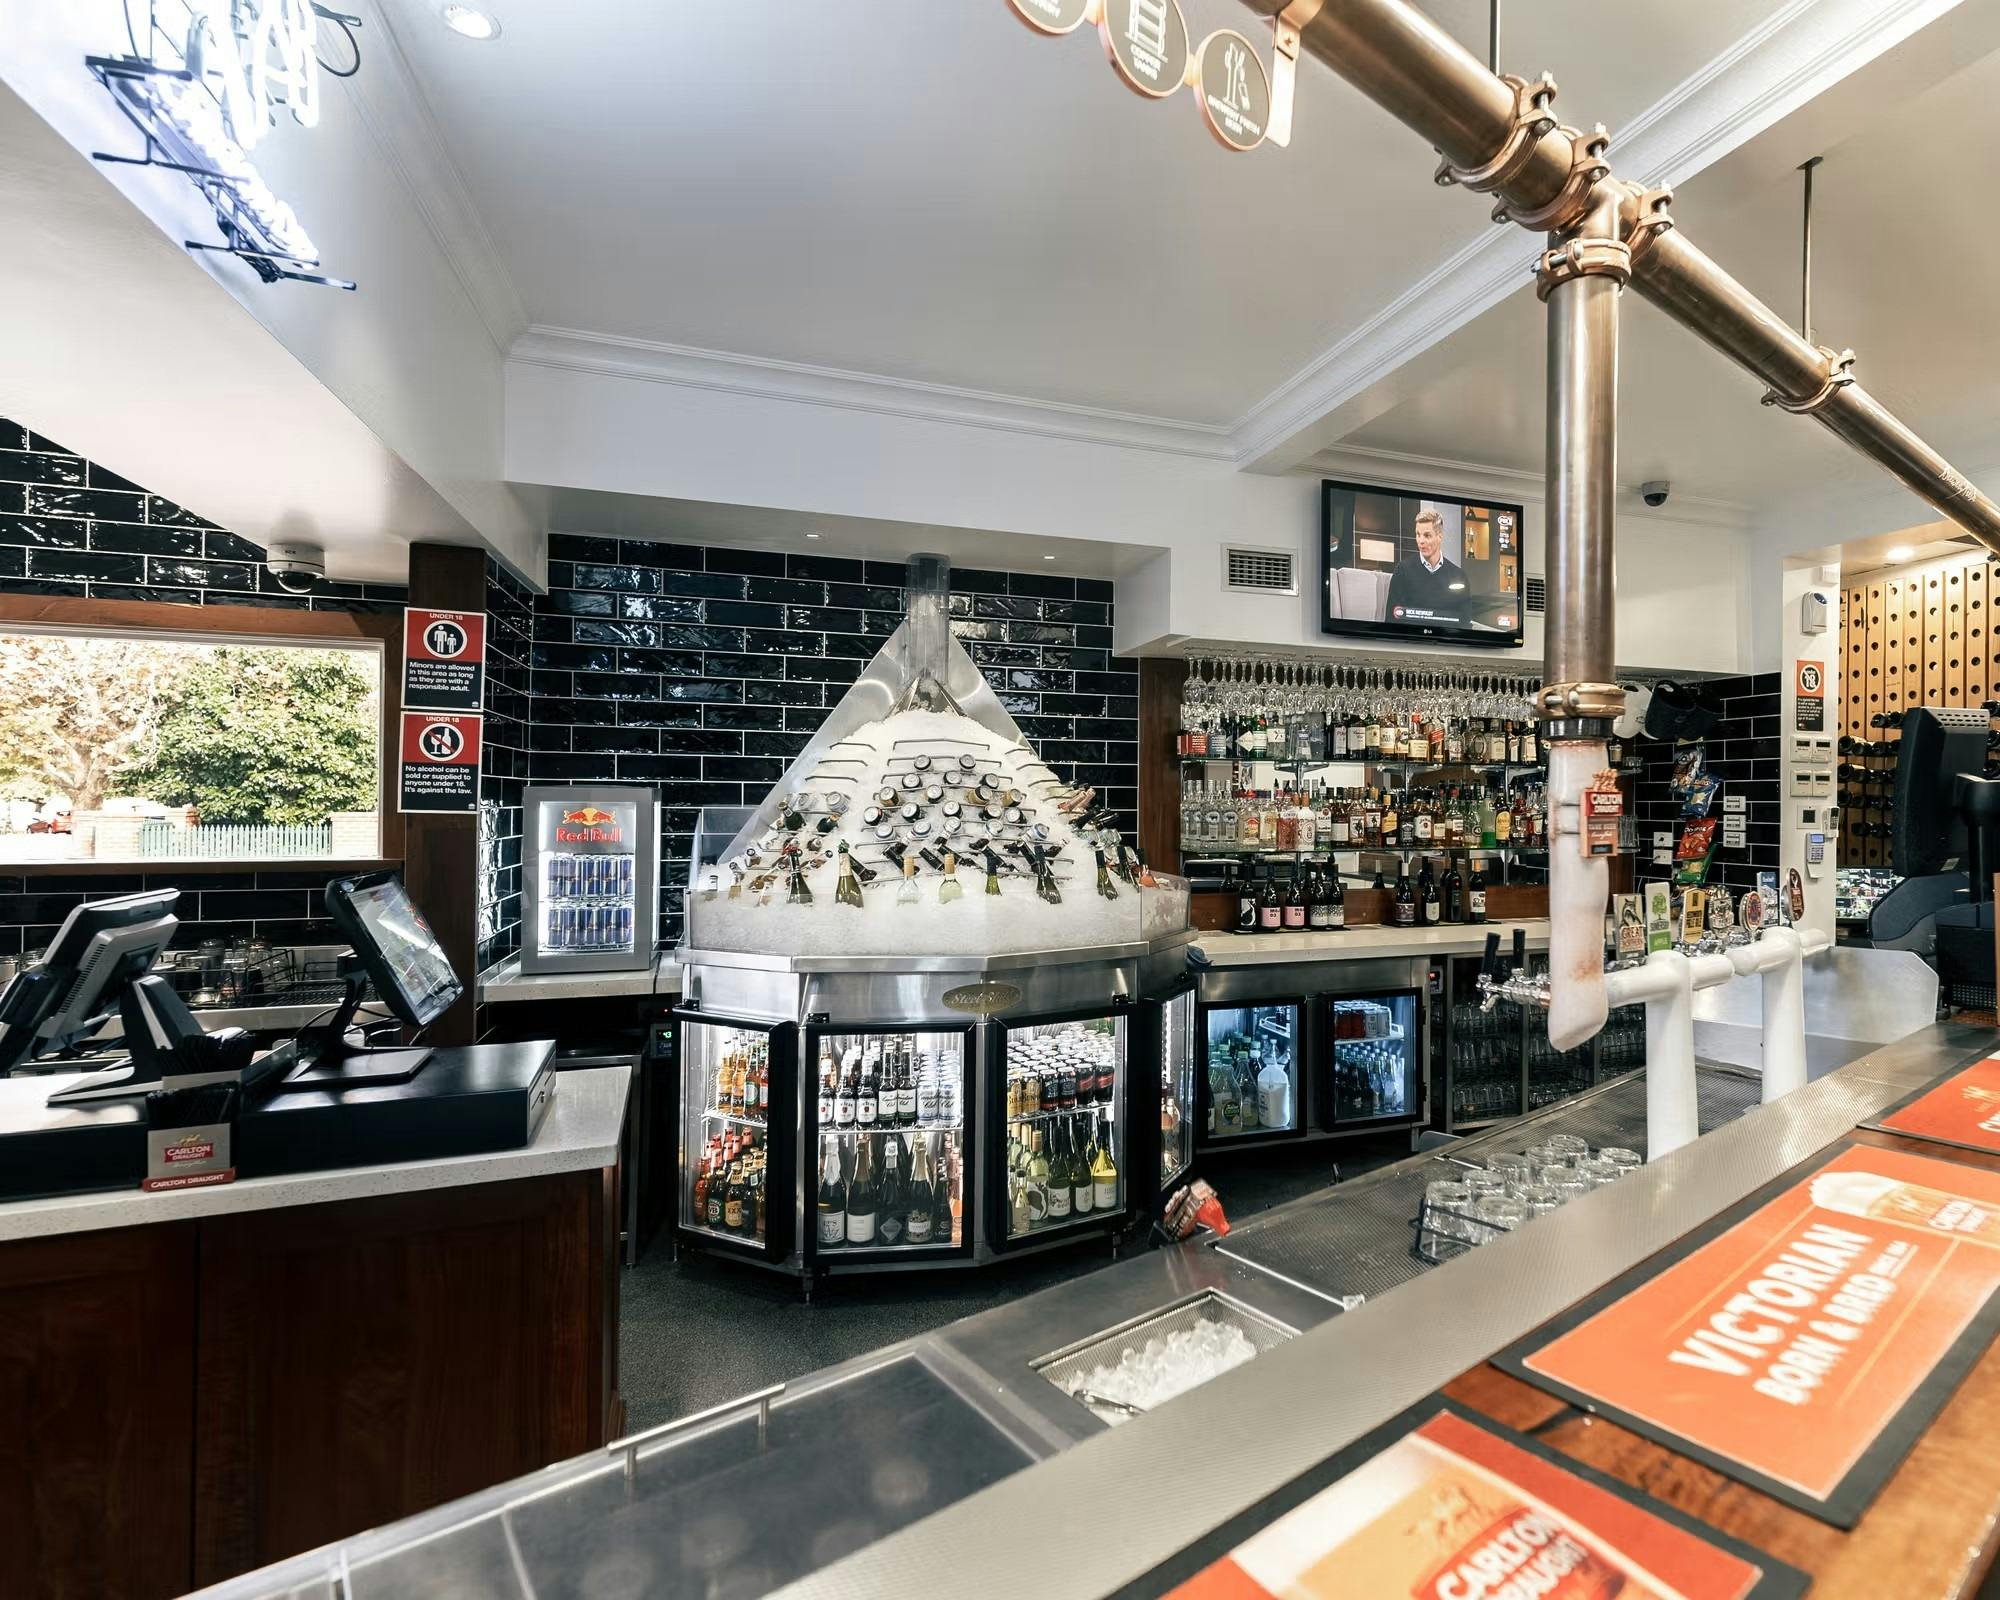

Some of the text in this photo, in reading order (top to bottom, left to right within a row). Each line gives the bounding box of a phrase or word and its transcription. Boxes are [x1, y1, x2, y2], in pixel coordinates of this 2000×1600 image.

[429, 612, 454, 620] UNDER
[409, 661, 434, 669] Minors
[408, 683, 449, 691] responsible
[419, 676, 434, 684] they
[556, 827, 622, 842] Red Bull
[167, 1145, 210, 1156] CARLTON
[172, 1152, 206, 1161] DRAUGHT
[151, 1174, 225, 1188] CARLTON DRAUGHT
[1667, 1222, 1875, 1377] VICTORIAN
[1821, 1273, 1897, 1325] BRED
[1808, 1319, 1863, 1341] &
[1752, 1333, 1849, 1406] BORN
[1436, 1511, 1562, 1600] CARLTON
